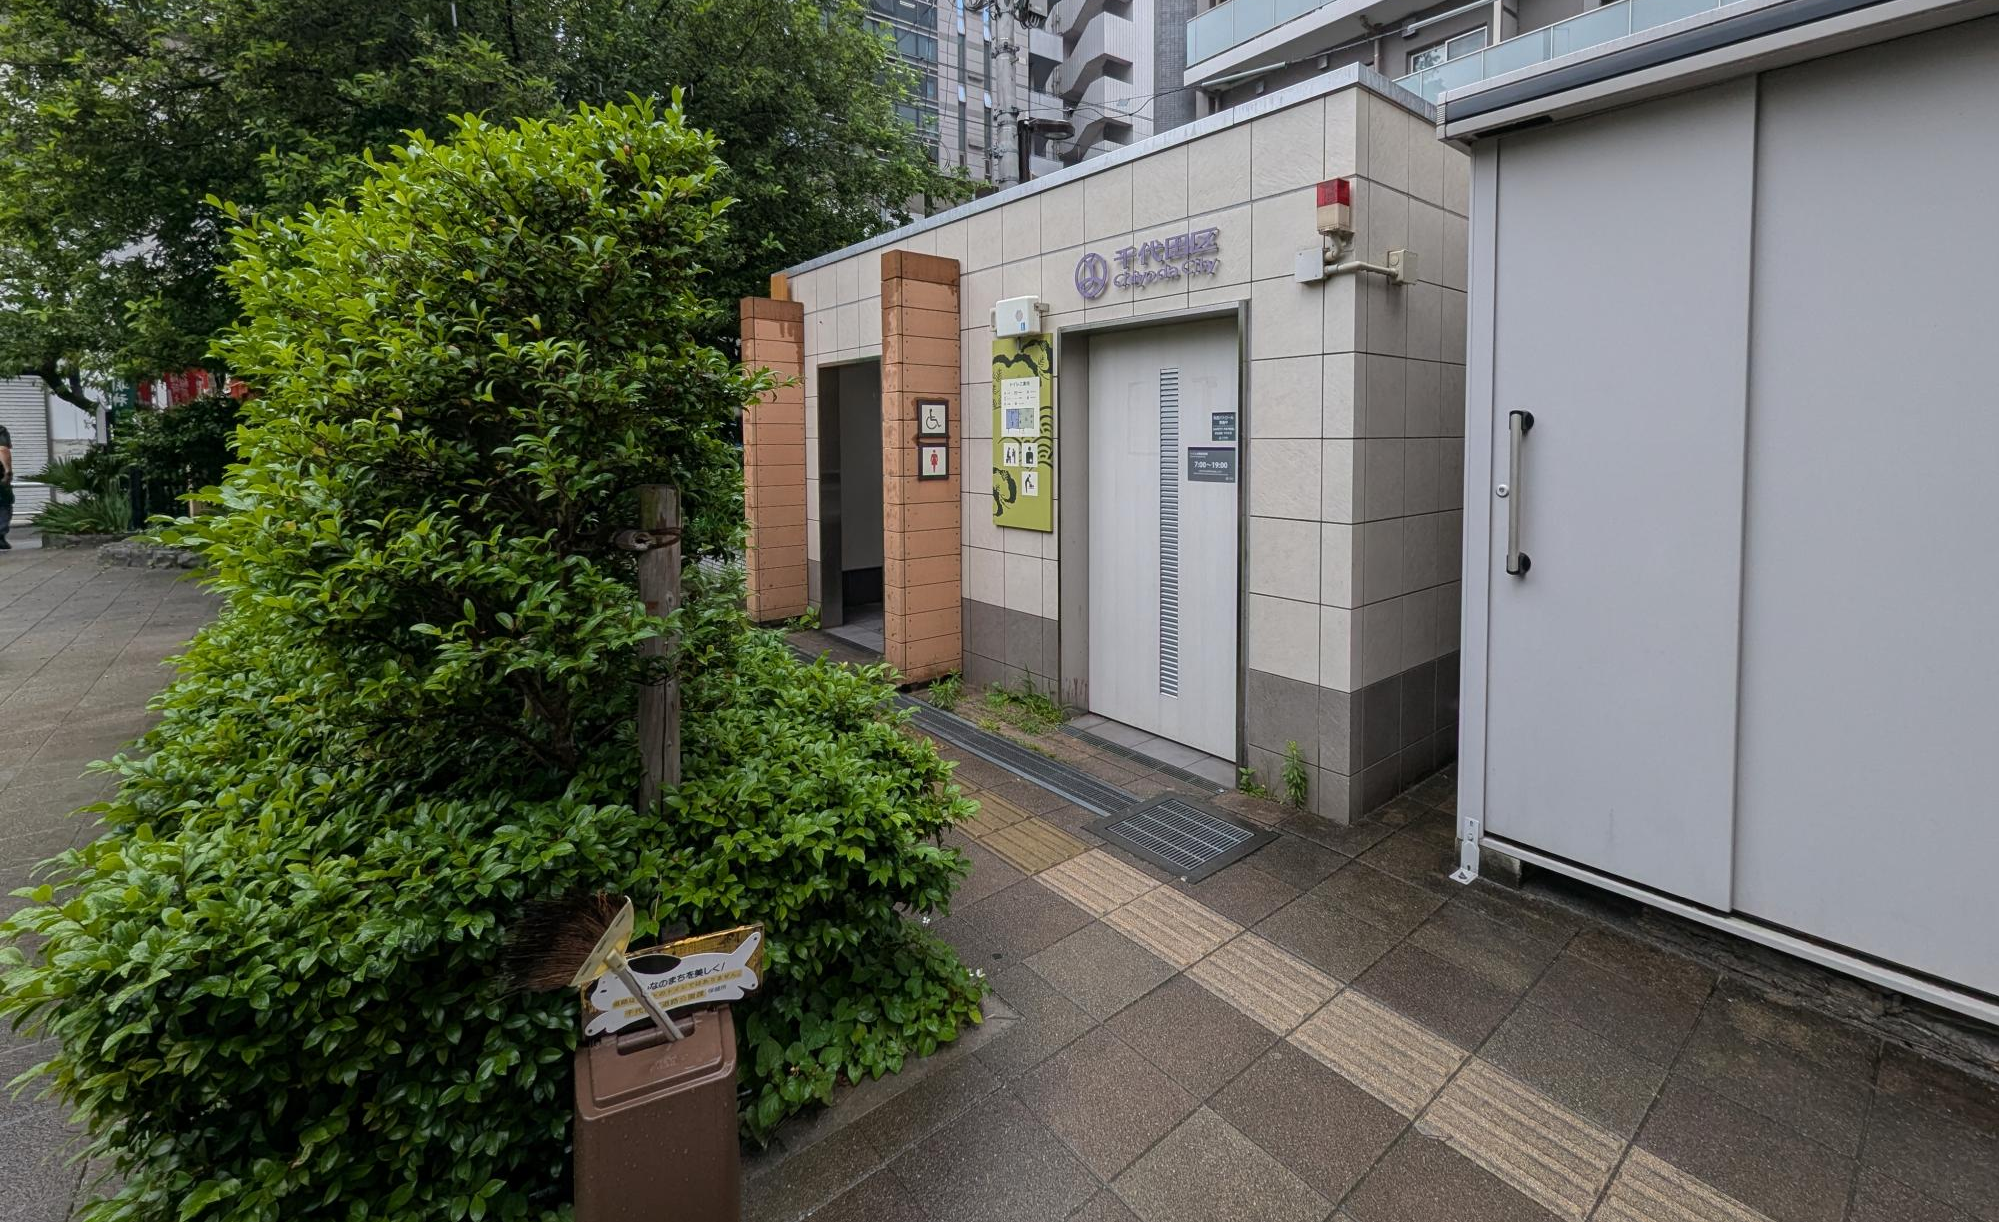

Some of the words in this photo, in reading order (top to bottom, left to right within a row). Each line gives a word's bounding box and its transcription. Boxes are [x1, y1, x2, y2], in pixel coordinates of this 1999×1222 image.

[1114, 227, 1219, 269] 千代田区
[1114, 264, 1181, 288] Chiyoda
[1182, 258, 1220, 275] City
